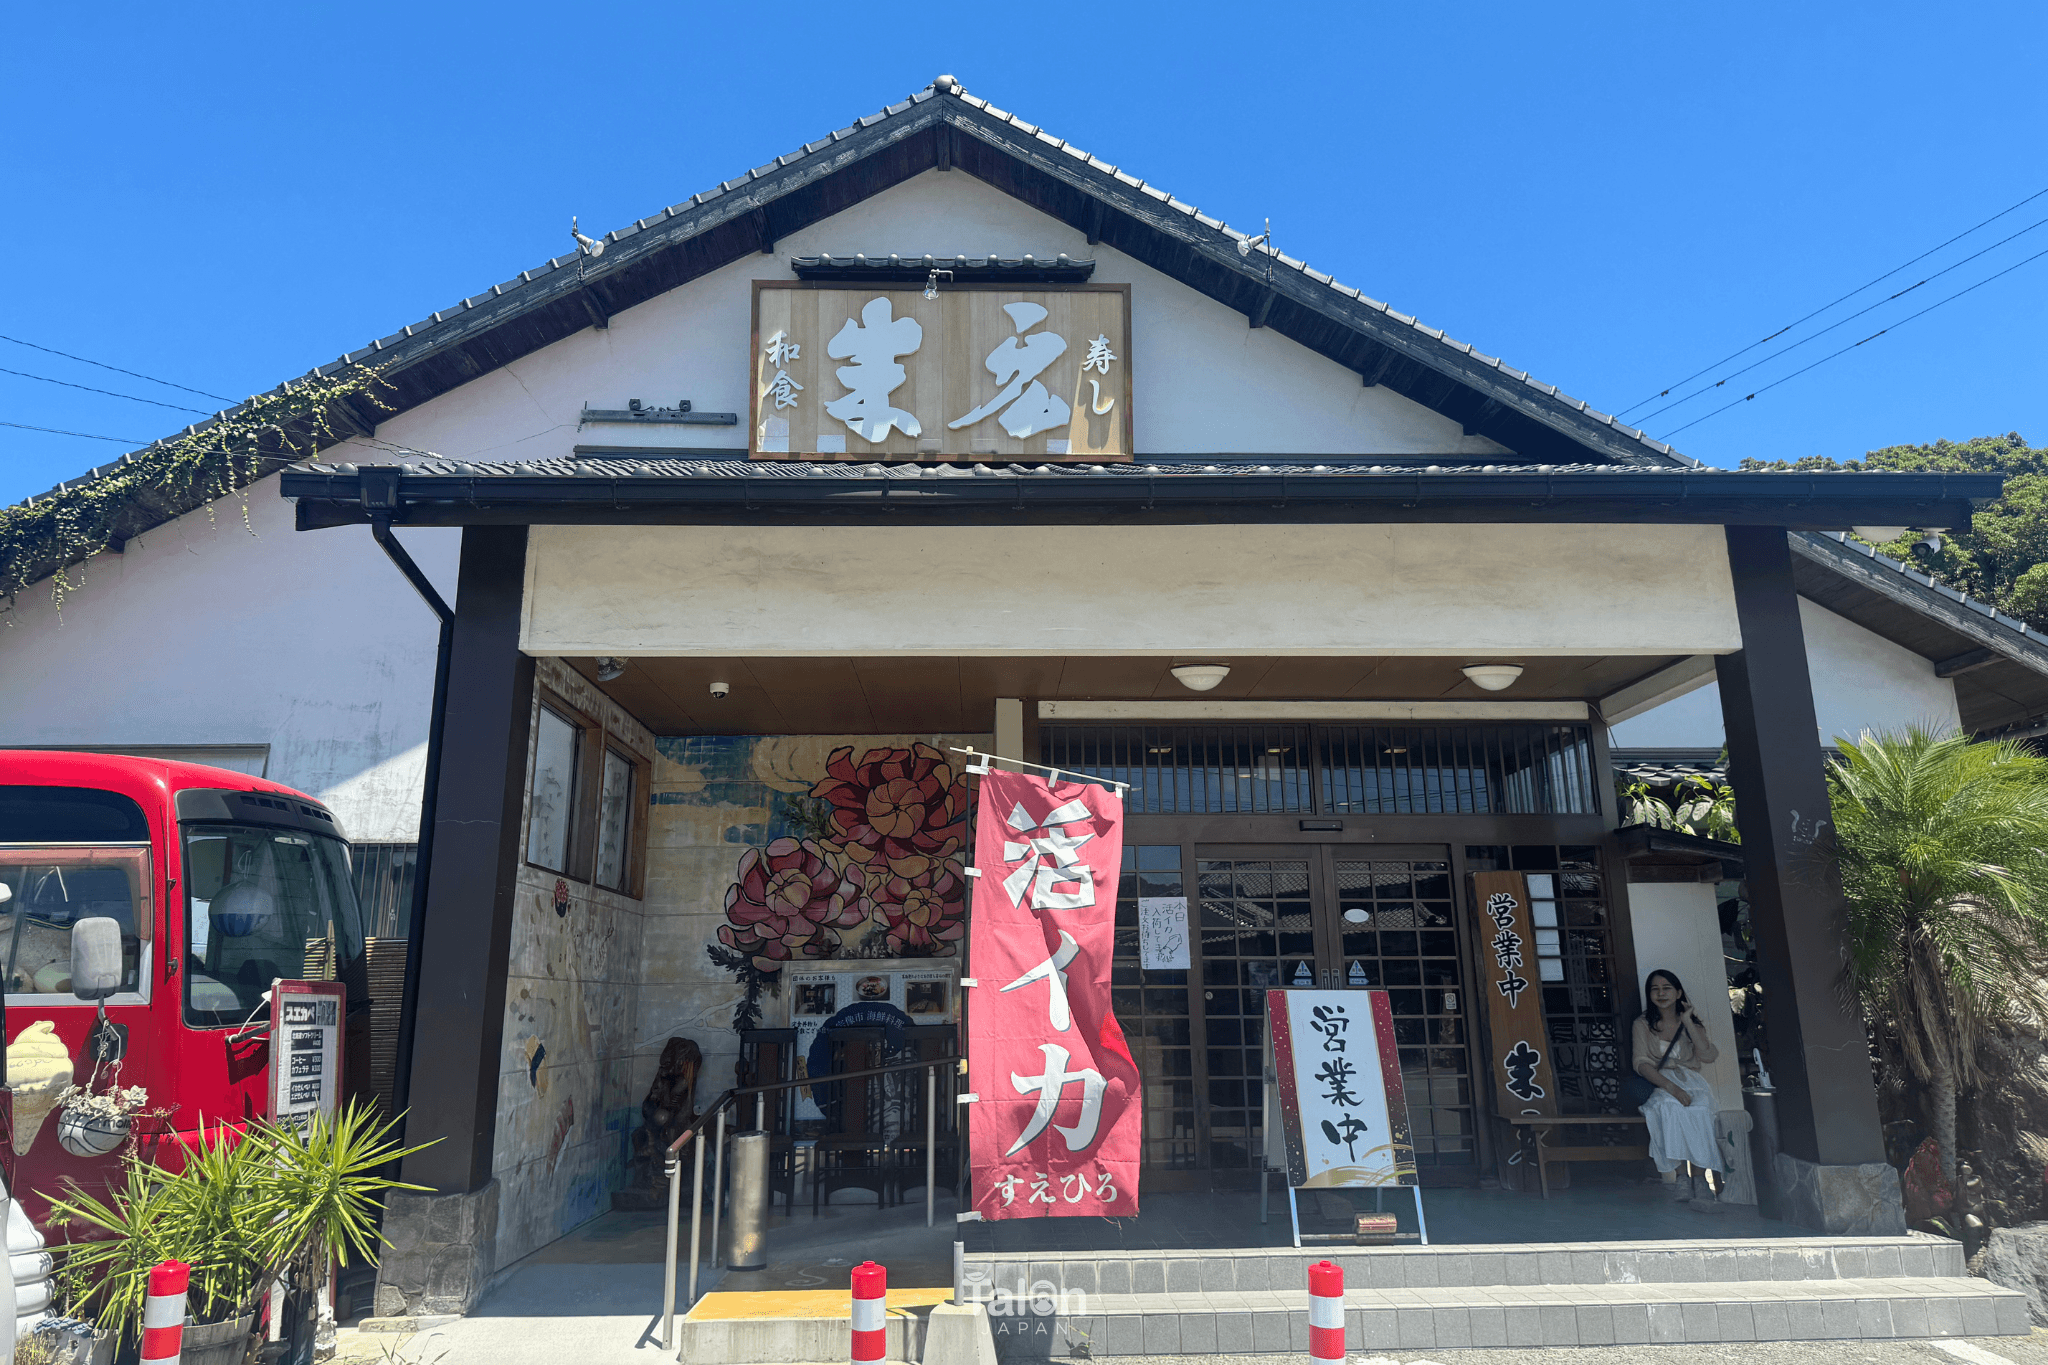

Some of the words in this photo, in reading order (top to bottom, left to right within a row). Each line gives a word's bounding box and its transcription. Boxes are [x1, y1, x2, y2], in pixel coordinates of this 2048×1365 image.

[763, 330, 804, 411] 和食
[1082, 333, 1118, 415] 寿し
[1162, 903, 1174, 934] 活イカ
[1173, 900, 1187, 922] 本日
[1486, 892, 1528, 1010] 営業中
[999, 799, 1108, 1158] 活イカ
[1310, 1005, 1368, 1163] 営業中
[994, 1171, 1119, 1209] すえひろ
